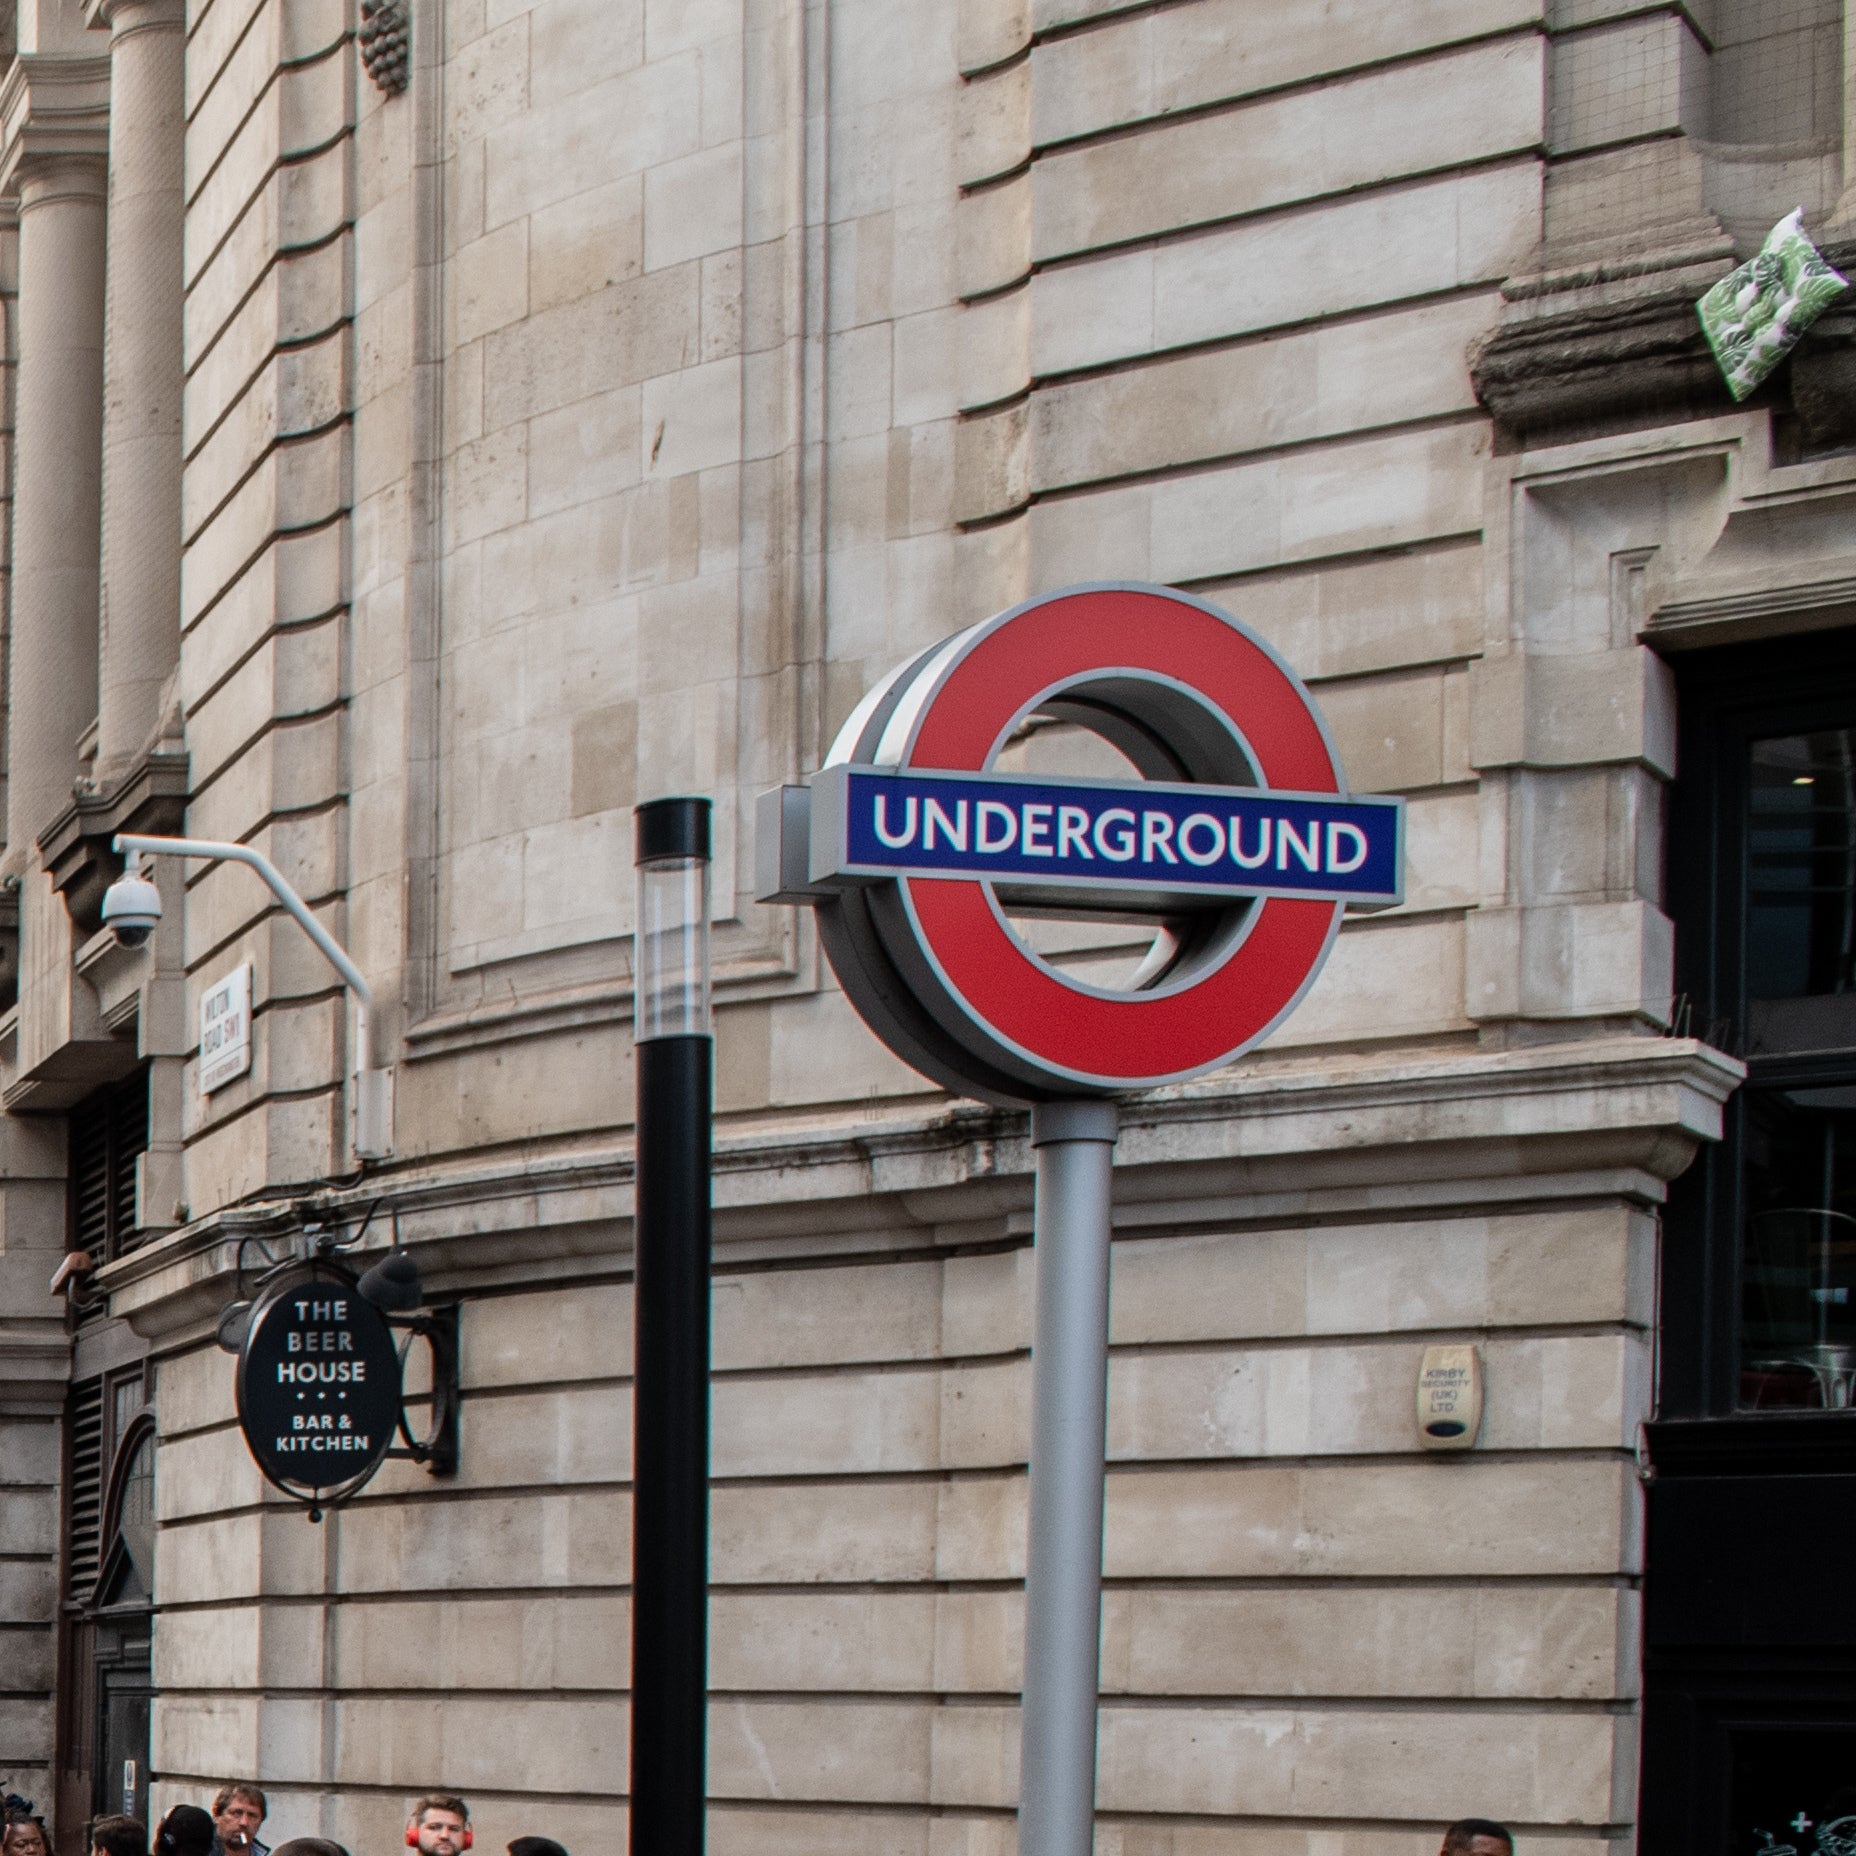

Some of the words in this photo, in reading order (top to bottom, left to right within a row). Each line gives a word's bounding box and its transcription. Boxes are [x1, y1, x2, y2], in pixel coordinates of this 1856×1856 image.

[873, 795, 1368, 875] UNDERGROUND
[295, 1300, 348, 1321] THE
[288, 1331, 353, 1352] BEER
[277, 1361, 366, 1383] HOUSE
[292, 1414, 334, 1430] BAR
[338, 1414, 352, 1430] &
[276, 1434, 368, 1451] KITCHEN
